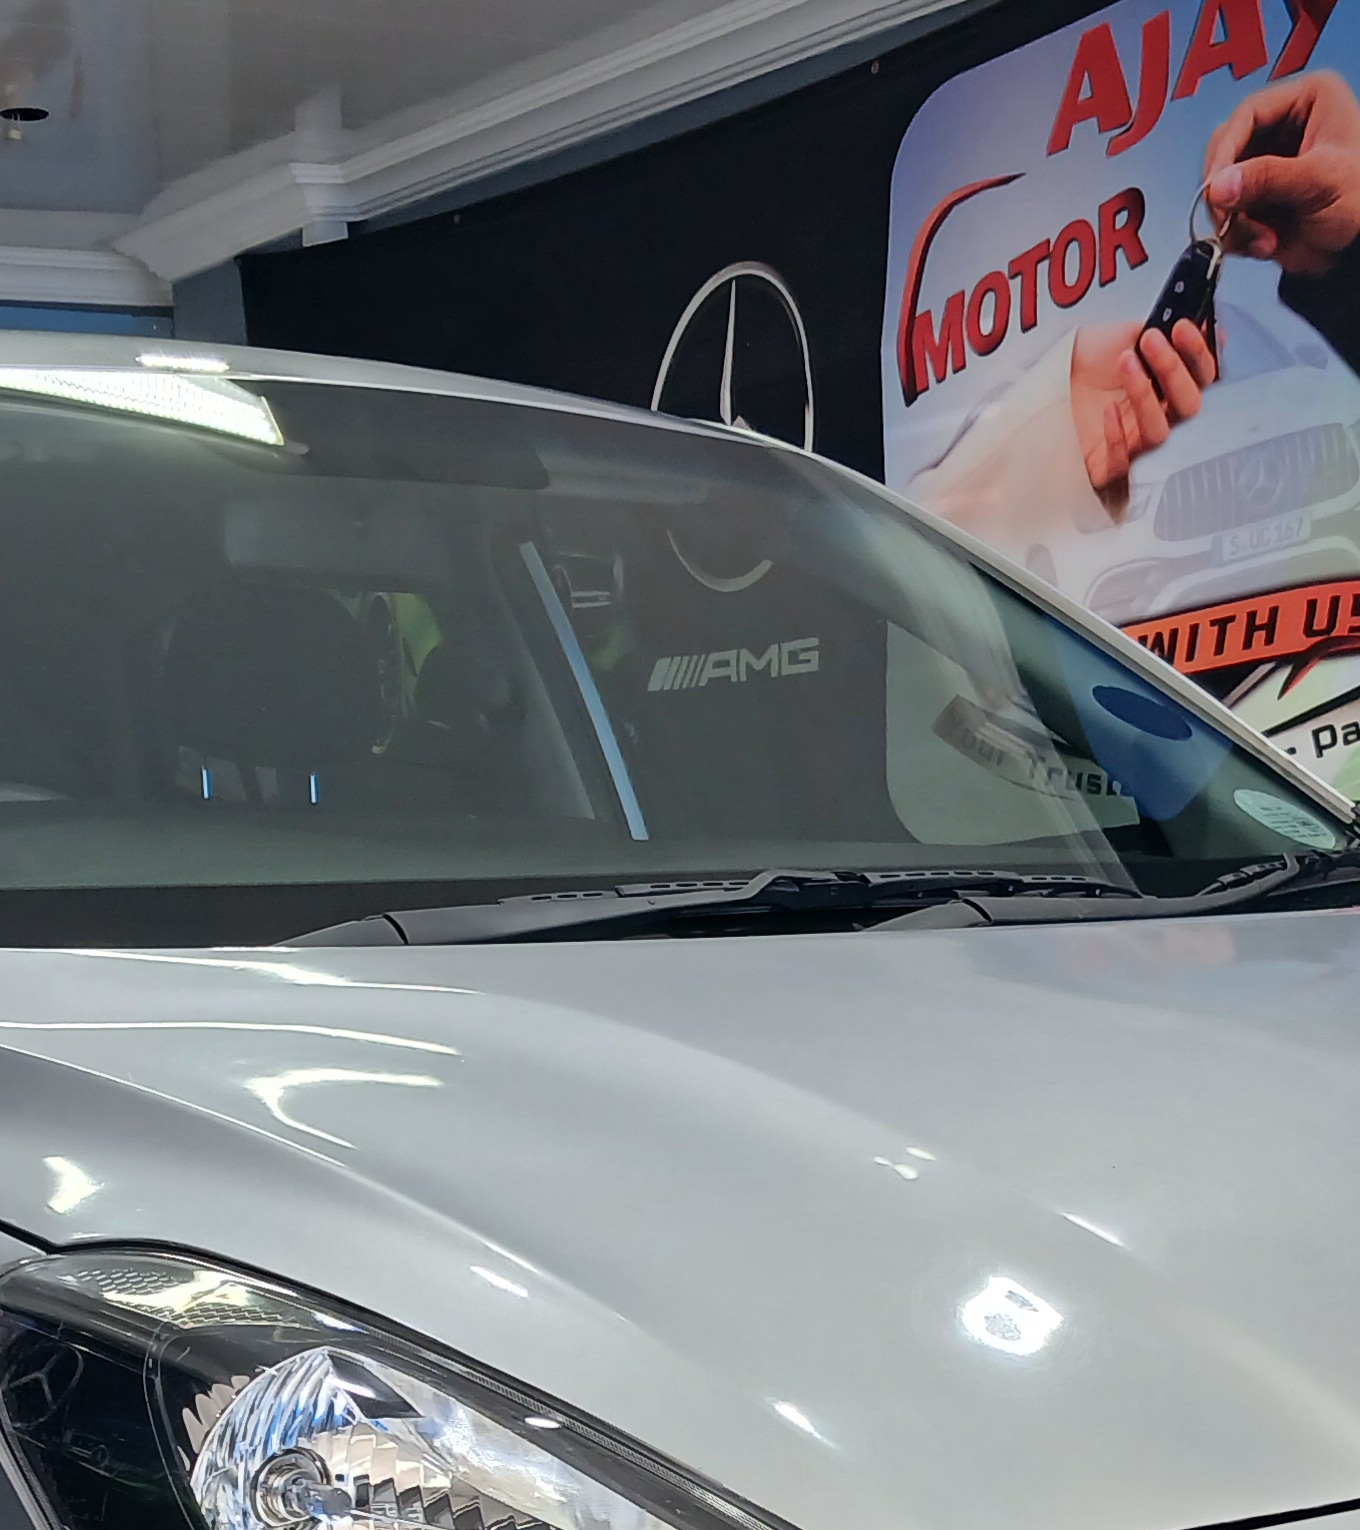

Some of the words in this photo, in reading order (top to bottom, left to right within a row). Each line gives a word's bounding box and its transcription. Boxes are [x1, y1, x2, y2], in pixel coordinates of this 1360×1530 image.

[1046, 0, 1340, 157] AJAY
[911, 187, 1148, 395] MOTOR
[1138, 605, 1280, 665] WITH
